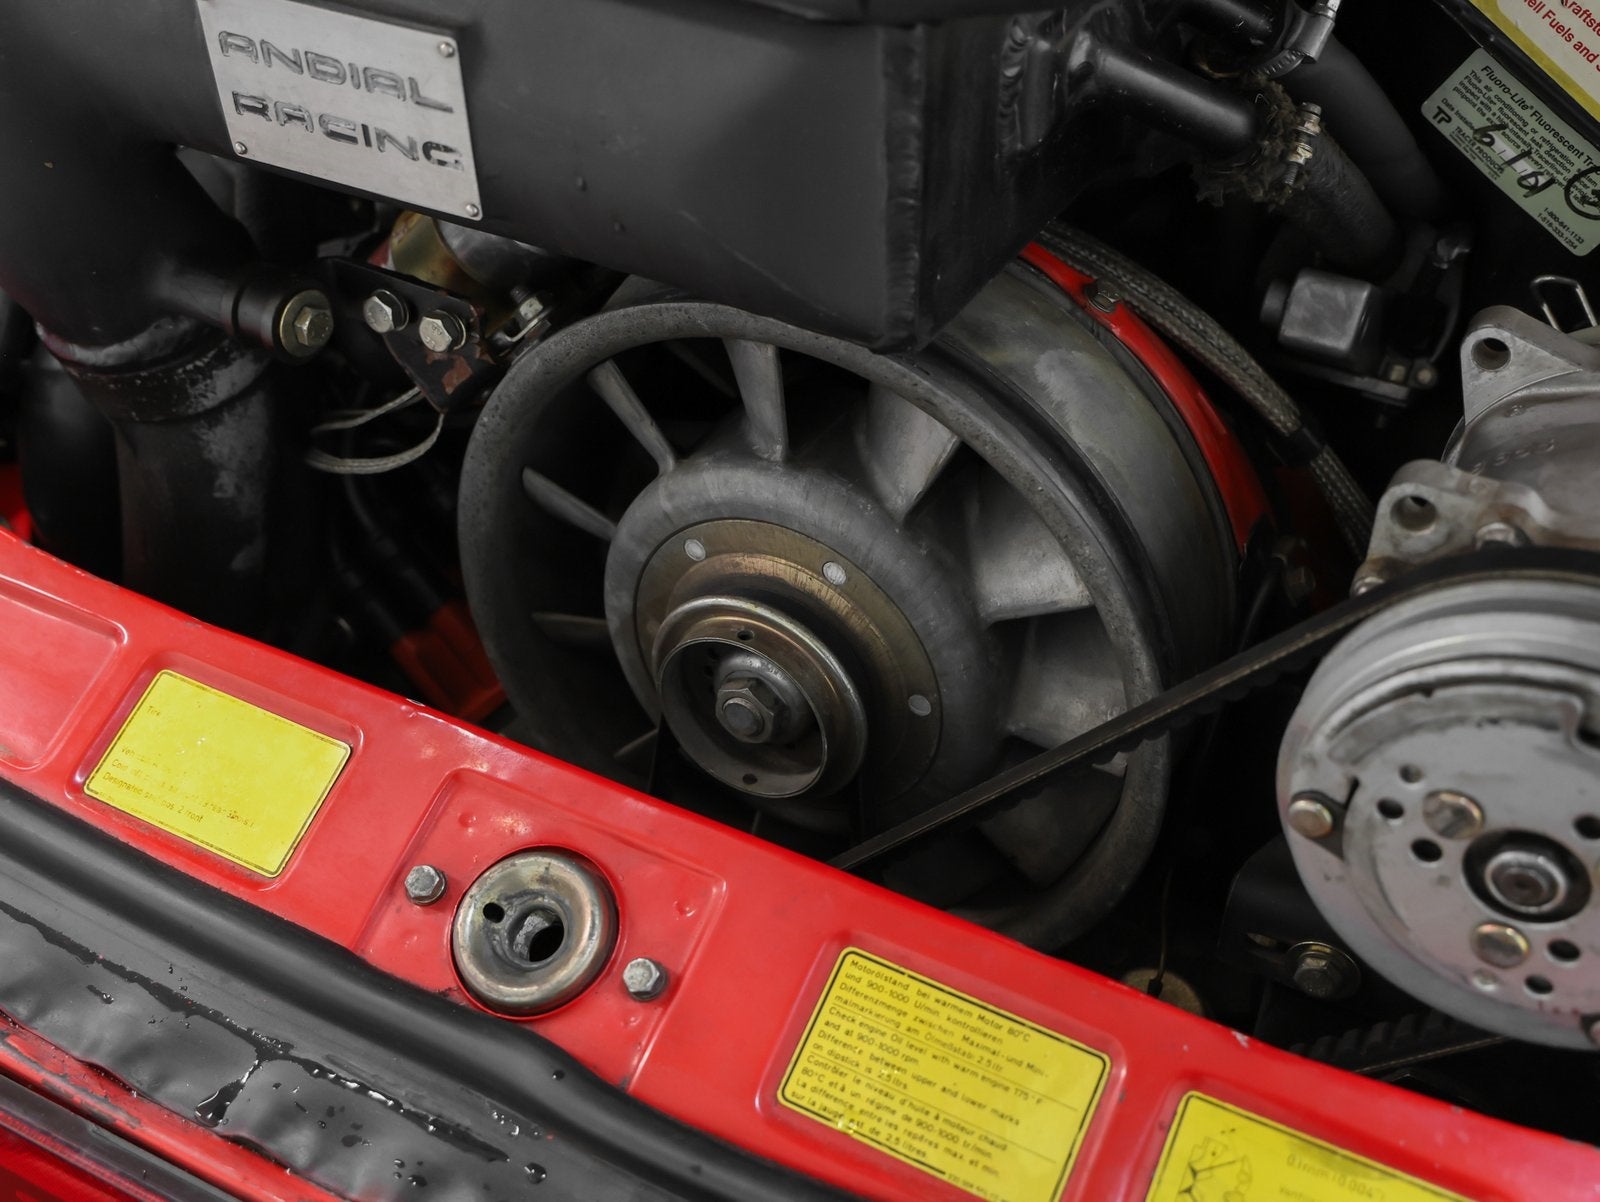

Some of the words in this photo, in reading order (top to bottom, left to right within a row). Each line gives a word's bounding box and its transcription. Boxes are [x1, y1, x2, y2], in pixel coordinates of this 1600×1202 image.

[1524, 0, 1546, 14] ell
[1541, 9, 1576, 43] Fuels
[1572, 39, 1600, 64] and
[1564, 0, 1600, 37] raftst
[217, 30, 455, 114] ANDIAL
[1457, 79, 1480, 101] Inspect
[1479, 99, 1492, 113] with
[231, 90, 465, 172] RACING
[1430, 105, 1453, 126] TP
[1440, 97, 1455, 112] Date
[1453, 109, 1480, 134] Installe
[1451, 85, 1477, 109] pinpoint
[1475, 106, 1487, 117] the
[1500, 130, 1521, 149] source
[1454, 125, 1476, 147] TRACER
[1468, 69, 1482, 84] This
[1483, 84, 1493, 93] air
[1493, 93, 1529, 128] conditioning
[1529, 127, 1538, 135] or
[1538, 134, 1575, 168] refrigeration
[1497, 106, 1530, 137] fluorescent
[1529, 135, 1543, 149] leak
[1543, 148, 1571, 174] detection
[1529, 109, 1584, 160] Fluorescent
[844, 971, 863, 984] und
[849, 958, 910, 991] Motorölstand
[915, 987, 931, 1000] bei
[933, 996, 973, 1018] warmem
[976, 1013, 1004, 1031] Motor
[823, 1019, 841, 1031] and
[843, 1028, 854, 1037] at
[833, 994, 902, 1029] malmarkierung
[905, 1025, 920, 1036] am
[838, 981, 908, 1018] Differenzmenge
[912, 1014, 954, 1037] zwischen
[812, 1042, 823, 1051] on
[826, 1048, 860, 1068] dipstick
[864, 1066, 872, 1074] is
[828, 1005, 856, 1024] Check
[857, 1020, 887, 1038] engine
[889, 1032, 904, 1045] Oil
[905, 1040, 925, 1054] level
[931, 1052, 950, 1064] with
[952, 1062, 979, 1078] warm
[817, 1029, 864, 1055] Difference
[868, 1052, 908, 1075] between
[910, 1073, 937, 1088] upper
[940, 1085, 959, 1098] and
[961, 1095, 987, 1110] lower
[990, 1107, 1020, 1126] marks
[827, 1079, 839, 1089] et
[839, 1083, 846, 1093] à
[849, 1089, 862, 1099] un
[901, 1112, 913, 1123] de
[790, 1090, 805, 1101] sur
[808, 1099, 817, 1107] la
[868, 1126, 881, 1137] de
[795, 1079, 807, 1089] La
[858, 1107, 883, 1123] entre
[884, 1120, 899, 1131] les
[968, 1158, 979, 1167] et
[852, 1075, 862, 1085] le
[864, 1082, 895, 1101] niveau
[941, 1117, 975, 1136] moteur
[977, 1133, 1008, 1152] chaud
